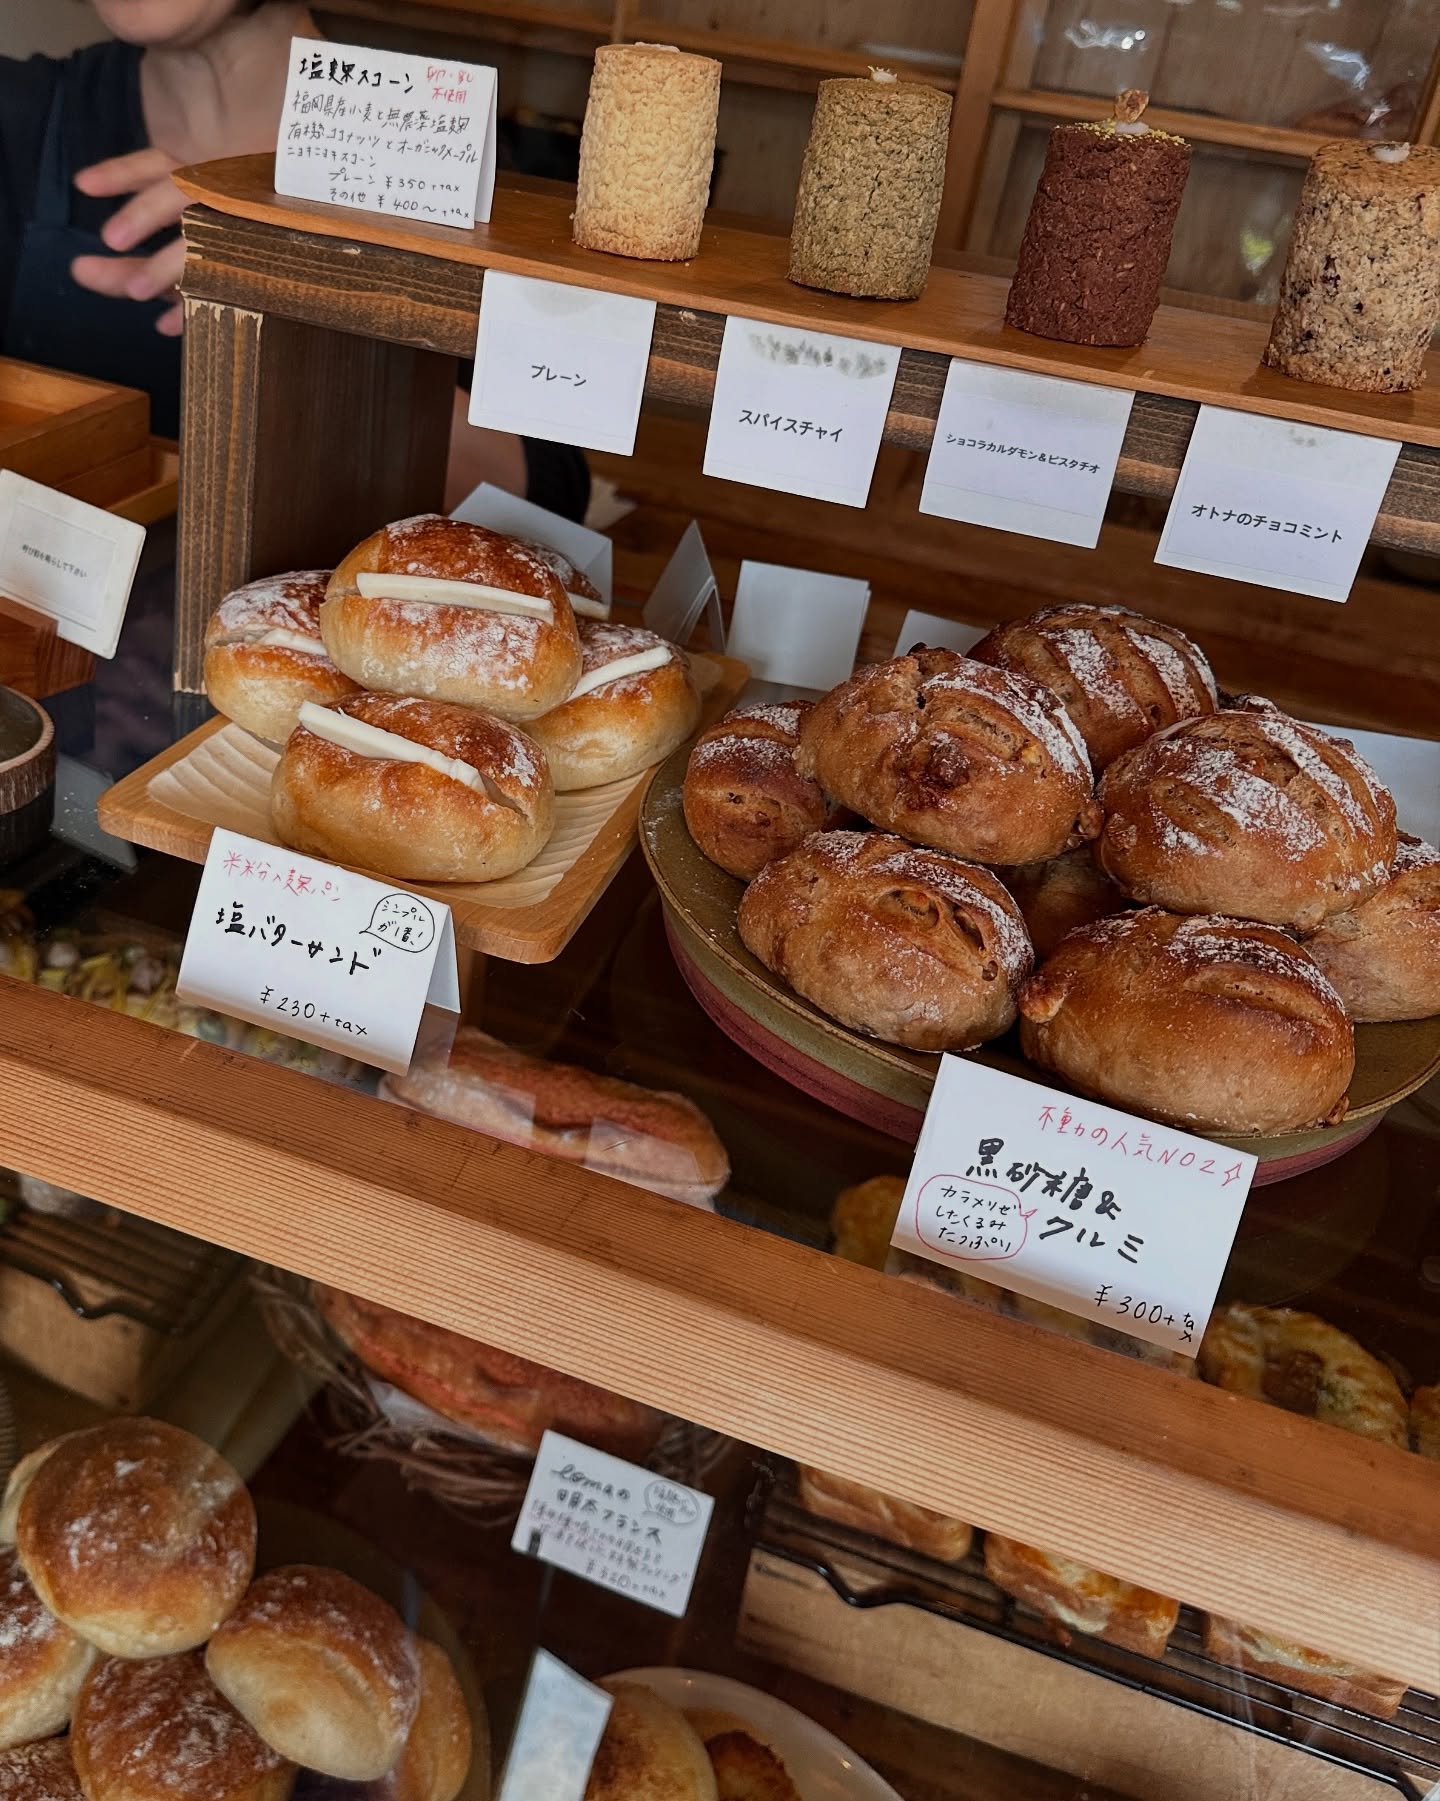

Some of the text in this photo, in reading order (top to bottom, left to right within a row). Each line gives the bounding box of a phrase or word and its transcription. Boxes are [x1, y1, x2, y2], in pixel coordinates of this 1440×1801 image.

[432, 87, 468, 104] 不使用
[328, 167, 375, 185] プレーン
[329, 188, 366, 203] その他
[531, 364, 587, 387] プレーン
[739, 410, 843, 443] スパイスチャイ
[946, 433, 1100, 475] ショコラカルダモン&ピスタチオ
[1191, 502, 1343, 544] オトナのチョコミント
[381, 900, 426, 922] シンプル
[215, 901, 382, 975] 塩バターサンド
[966, 1137, 1122, 1220] 黒砂糖&
[941, 1185, 1021, 1216] カラメリゼ
[936, 1206, 1007, 1231] したくるみ
[938, 1227, 1012, 1252] たっぷり
[1039, 1216, 1144, 1263] クルミ
